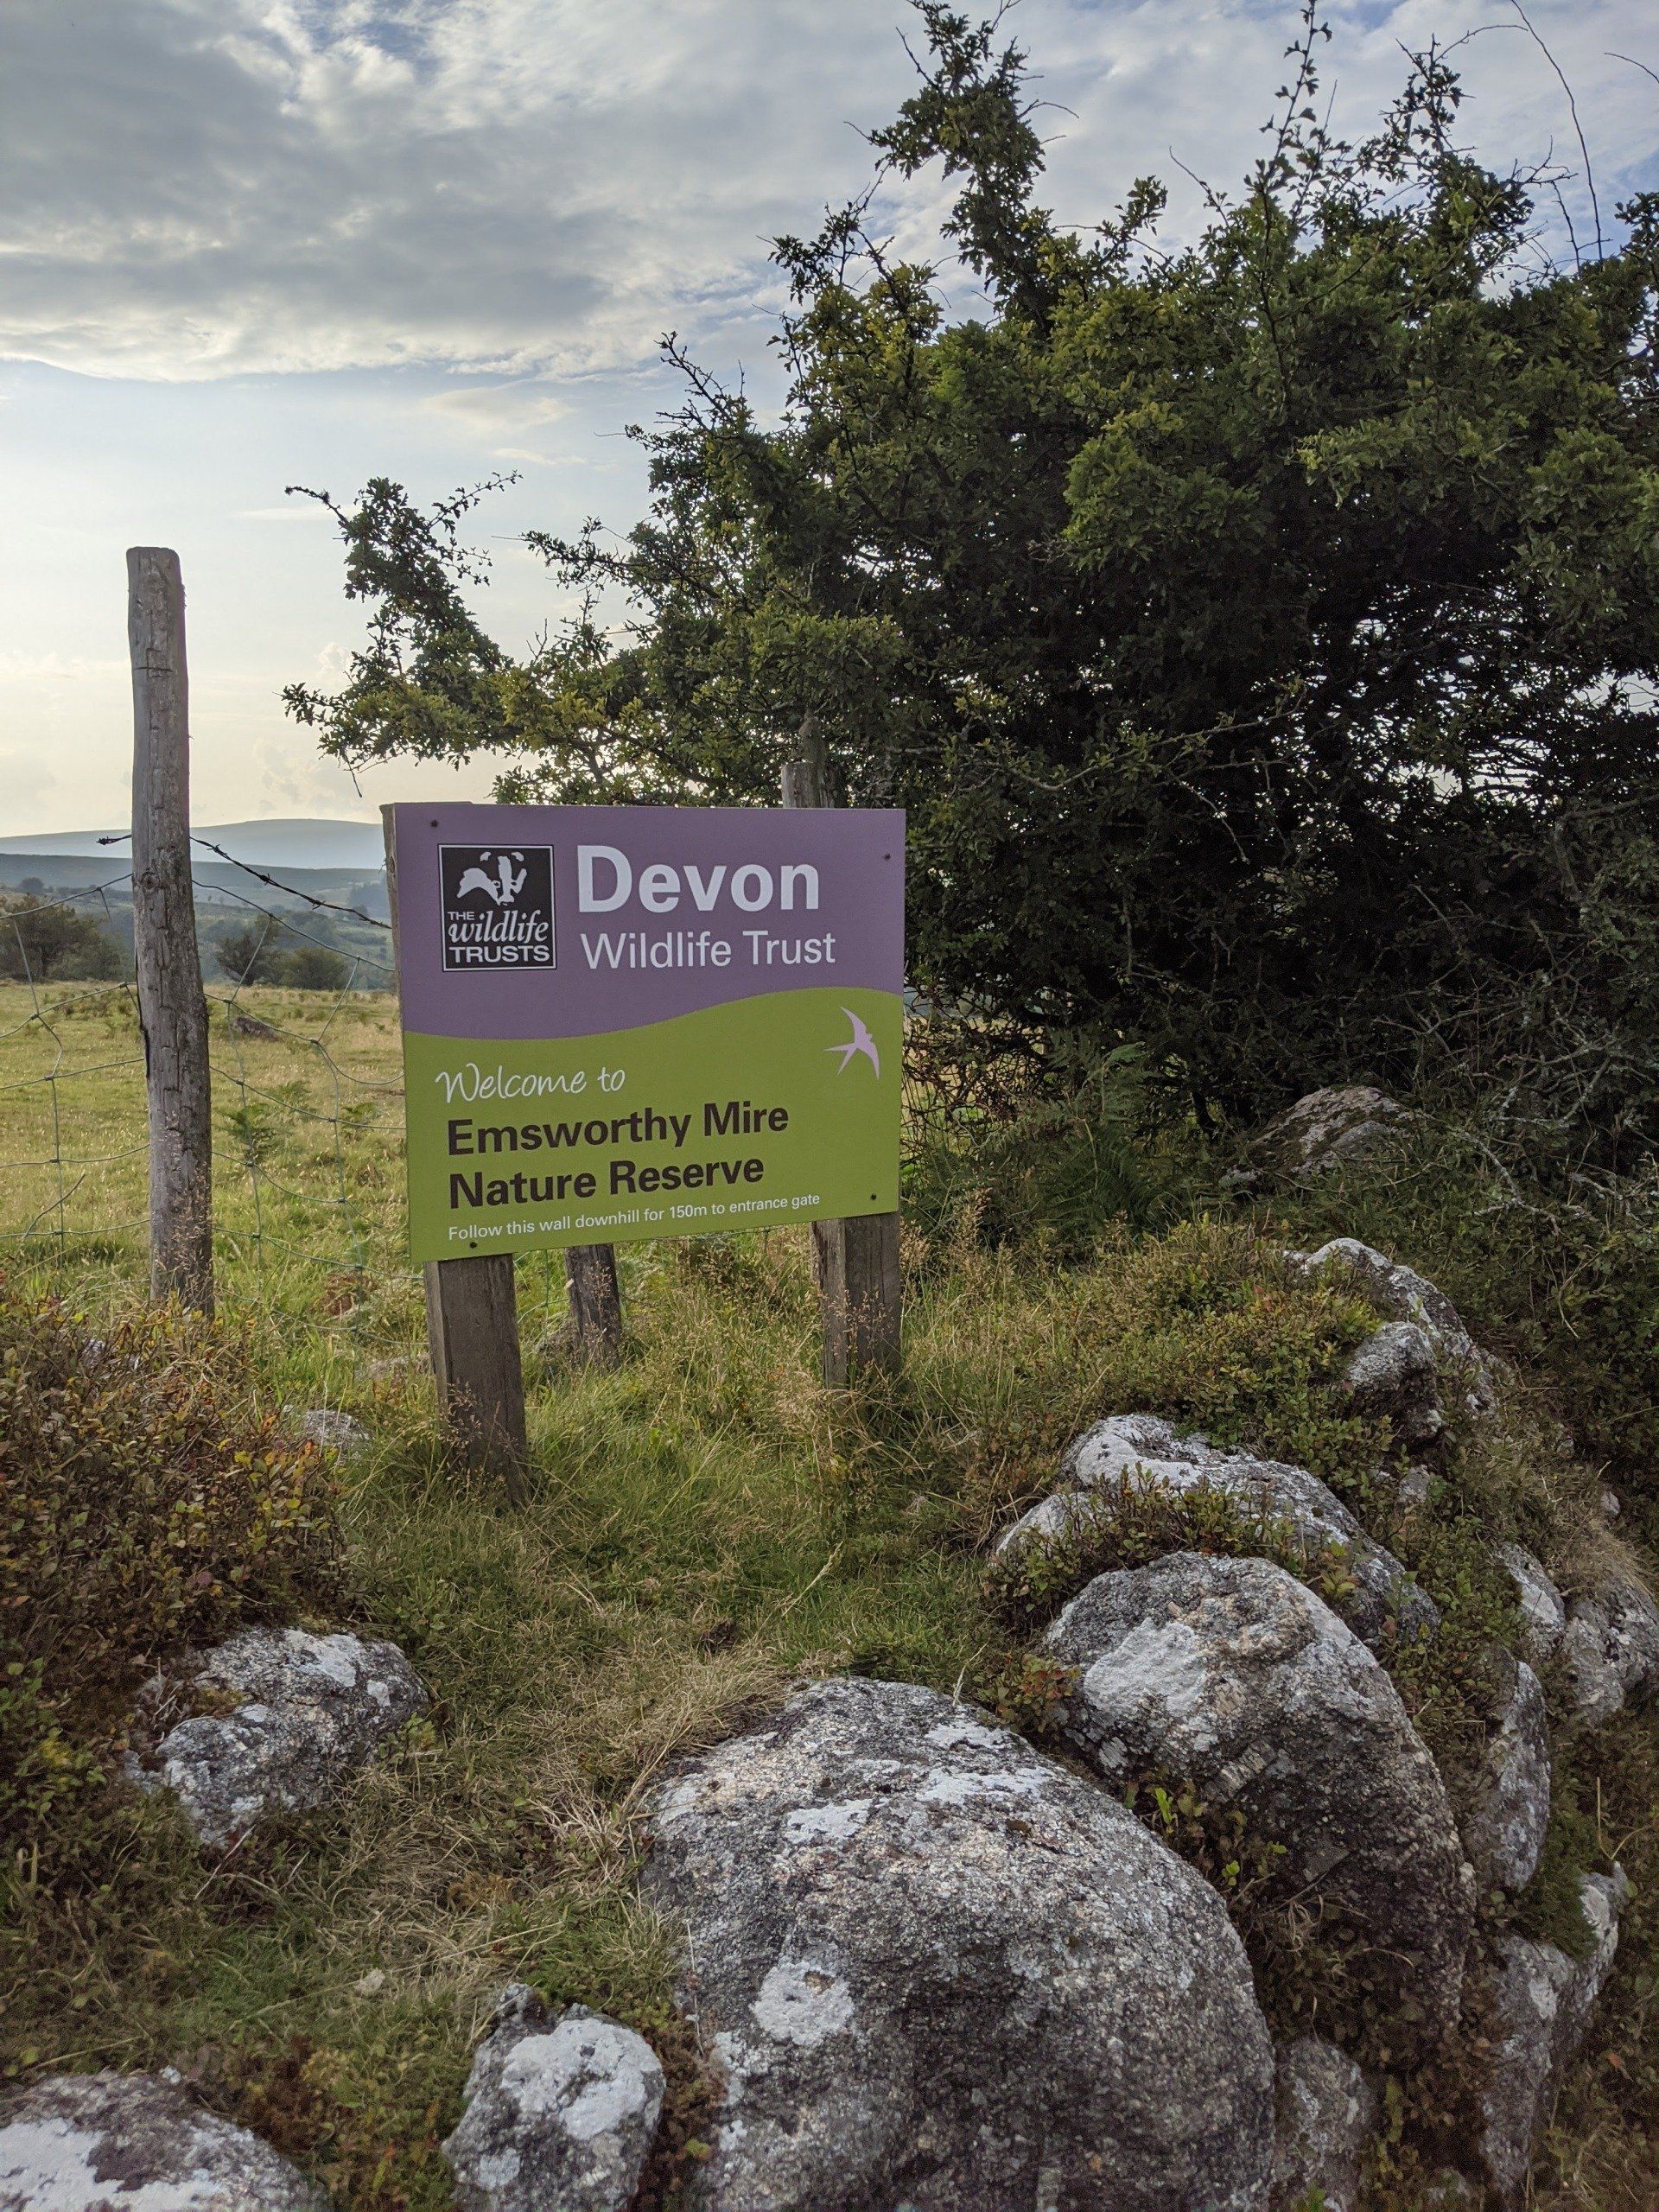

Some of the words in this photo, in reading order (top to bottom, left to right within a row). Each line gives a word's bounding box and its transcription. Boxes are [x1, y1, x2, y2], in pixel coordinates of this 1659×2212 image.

[577, 845, 820, 912] Devon
[447, 911, 475, 921] THE
[448, 909, 550, 944] wildlife
[448, 944, 550, 963] TRUSTS
[580, 931, 732, 969] Wildlife
[742, 931, 836, 964] Trust
[435, 1063, 587, 1103] Welcome
[597, 1066, 626, 1091] to
[448, 1107, 692, 1155] Emsworthy
[703, 1100, 789, 1136] Mire
[449, 1171, 597, 1209] Nature
[609, 1157, 764, 1195] Reserve
[448, 1224, 502, 1241] Follow
[506, 1219, 535, 1234] this
[539, 1216, 570, 1231] wall
[575, 1210, 639, 1229] downhill
[644, 1207, 664, 1221] for
[670, 1205, 707, 1218] 150m
[711, 1203, 725, 1215] to
[729, 1198, 788, 1213] entrance
[791, 1193, 820, 1210] gate
